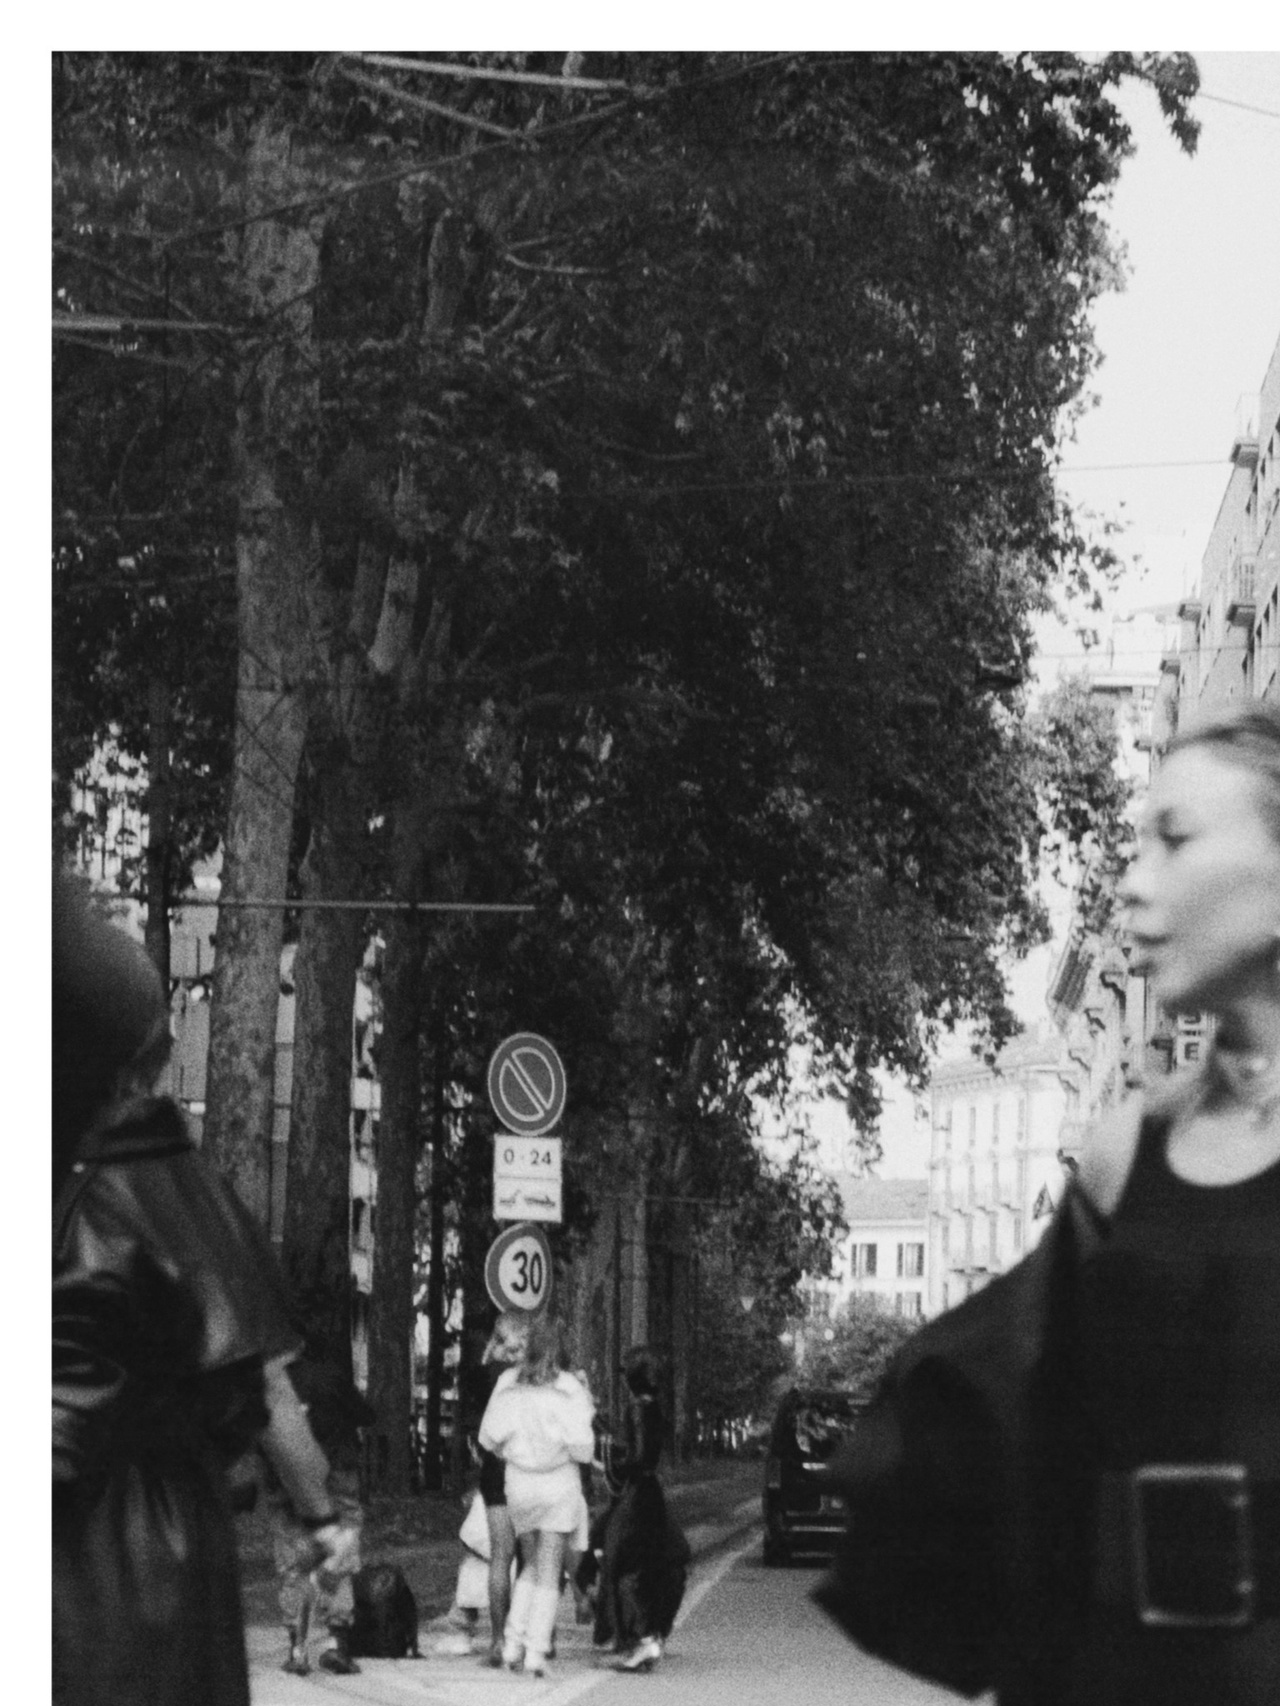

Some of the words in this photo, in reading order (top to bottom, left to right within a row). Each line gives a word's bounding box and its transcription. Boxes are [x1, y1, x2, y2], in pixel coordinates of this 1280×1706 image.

[503, 1148, 515, 1165] 0
[530, 1148, 552, 1165] 24
[510, 1250, 543, 1295] 30
